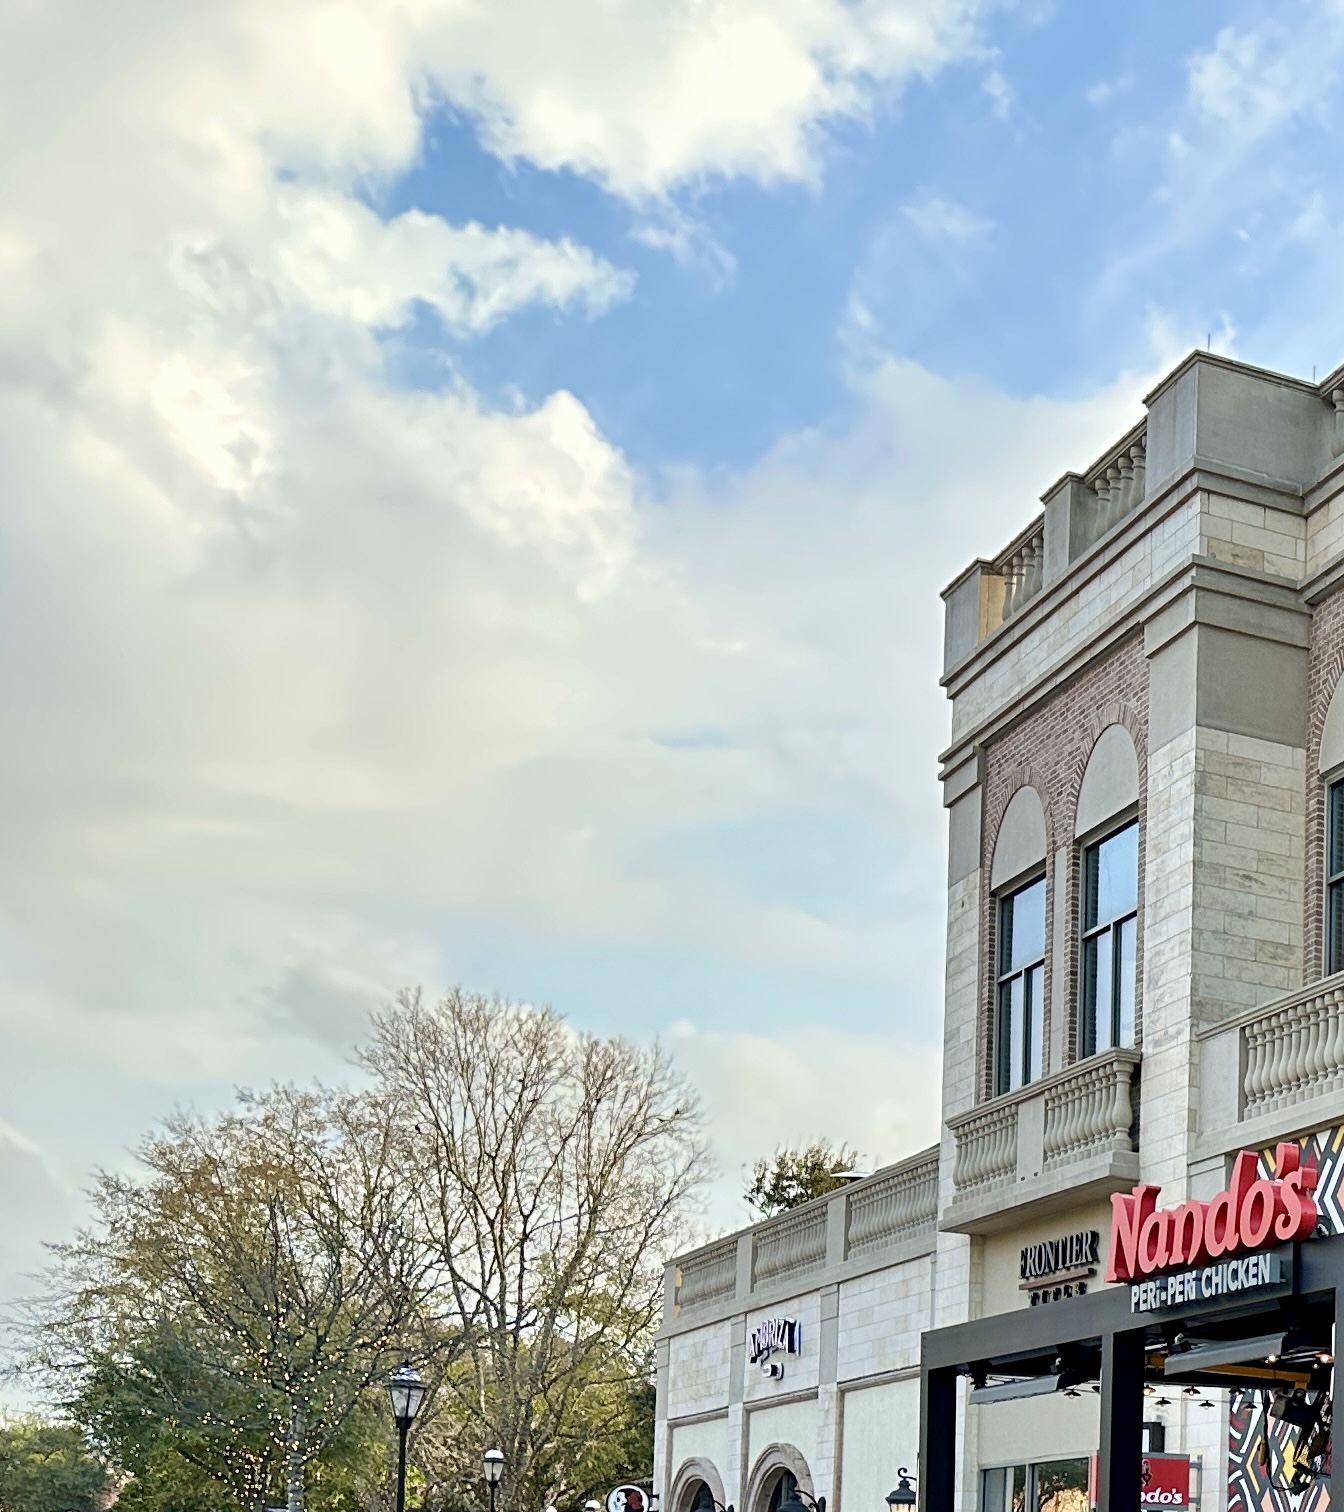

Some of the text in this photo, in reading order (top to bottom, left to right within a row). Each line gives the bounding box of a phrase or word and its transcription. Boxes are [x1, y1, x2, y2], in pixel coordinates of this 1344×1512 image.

[1105, 1142, 1318, 1284] Nando's
[1019, 1230, 1100, 1281] FRONTIER
[1200, 1252, 1272, 1299] CHICKEN
